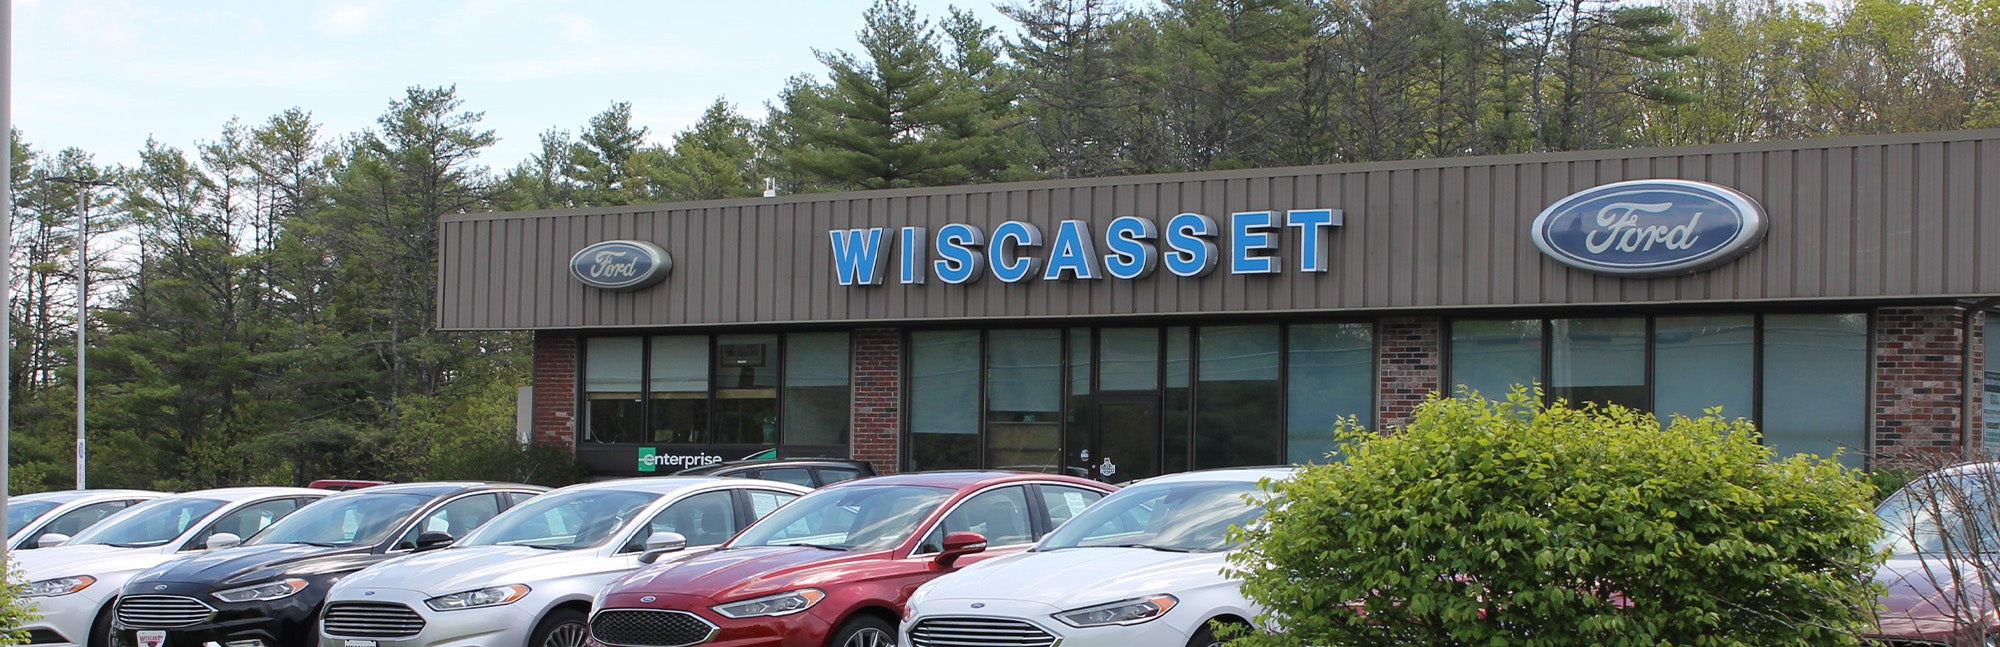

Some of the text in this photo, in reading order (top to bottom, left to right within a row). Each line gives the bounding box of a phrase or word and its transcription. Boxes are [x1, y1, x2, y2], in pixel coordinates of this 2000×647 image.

[829, 209, 1342, 286] WISCASSET
[1585, 202, 1702, 254] Ford
[590, 250, 638, 277] Ford
[642, 452, 723, 469] enterprise
